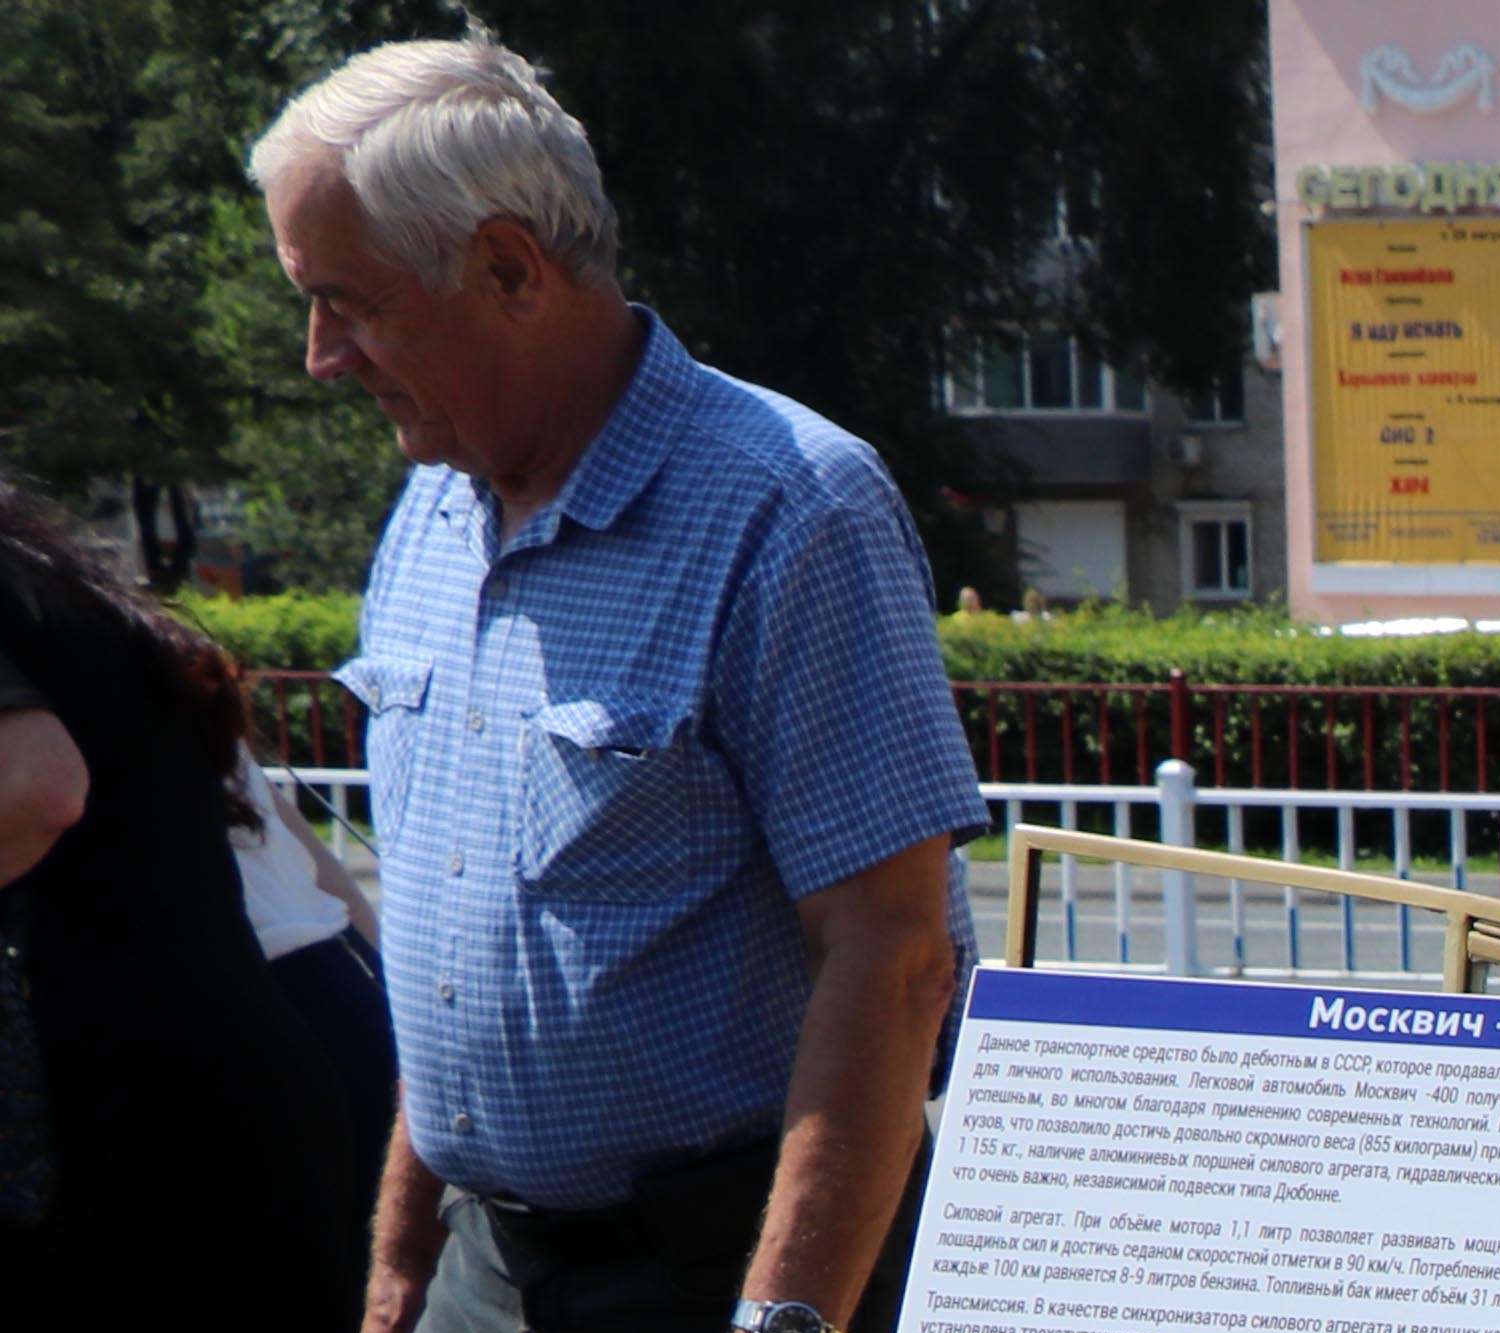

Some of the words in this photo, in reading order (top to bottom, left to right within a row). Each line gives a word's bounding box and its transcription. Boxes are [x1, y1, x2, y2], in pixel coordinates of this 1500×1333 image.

[1309, 996, 1484, 1037] Москвич
[976, 1031, 1031, 1054] Данное
[1033, 1038, 1130, 1061] транспортное
[1131, 1044, 1198, 1065] средство
[1199, 1044, 1239, 1065] было
[1238, 1047, 1319, 1070] дебютным
[1332, 1052, 1373, 1075] СССР,
[1373, 1058, 1434, 1079] которое
[971, 1061, 1001, 1080] для
[1005, 1063, 1064, 1081] личного
[1069, 1067, 1180, 1088] использования.
[1186, 1069, 1255, 1092] Легковой
[1260, 1076, 1347, 1098] автомобиль
[1353, 1079, 1418, 1102] Москвич
[1424, 1084, 1460, 1104] -400
[966, 1087, 1045, 1108] успешным,
[1072, 1093, 1128, 1111] многом
[1131, 1092, 1207, 1119] благодаря
[1210, 1101, 1302, 1122] применению
[1305, 1107, 1404, 1128] современных
[1408, 1112, 1491, 1133] технологий.
[961, 1113, 1006, 1132] кузов,
[1008, 1116, 1034, 1132] что
[1034, 1117, 1111, 1136] позволило
[1110, 1122, 1172, 1141] достичь
[1171, 1125, 1243, 1144] довольно
[1243, 1129, 1321, 1150] скромного
[1321, 1134, 1357, 1151] веса
[1357, 1132, 1393, 1156] (855
[1392, 1138, 1478, 1162] килограмм)
[971, 1135, 999, 1156] 155
[999, 1142, 1023, 1160] кг.,
[1026, 1143, 1086, 1162] наличие
[1087, 1146, 1190, 1168] алюминиевых
[1191, 1152, 1256, 1173] поршней
[1257, 1157, 1324, 1176] силового
[1326, 1161, 1392, 1183] агрегата,
[951, 1165, 977, 1181] что
[977, 1166, 1020, 1184] очень
[1021, 1169, 1070, 1190] важно,
[1071, 1172, 1167, 1192] независимой
[1167, 1178, 1237, 1198] подвески
[1238, 1182, 1272, 1199] типа
[1271, 1180, 1342, 1204] Дюбонне.
